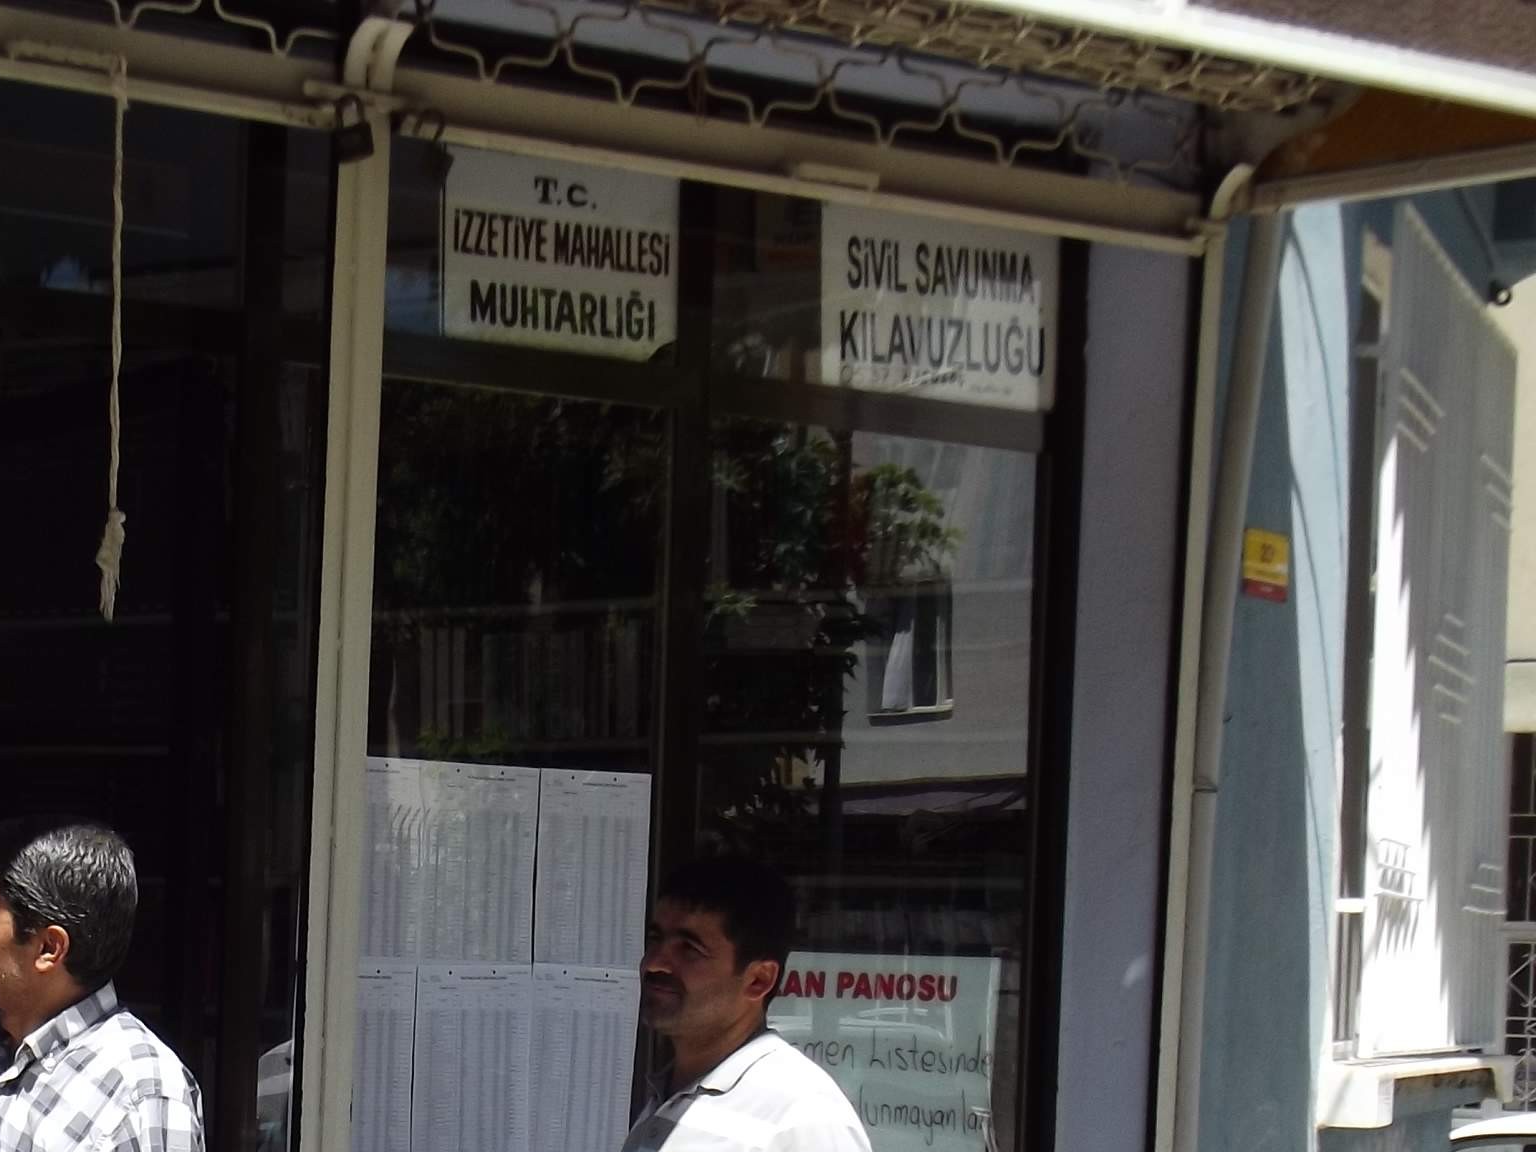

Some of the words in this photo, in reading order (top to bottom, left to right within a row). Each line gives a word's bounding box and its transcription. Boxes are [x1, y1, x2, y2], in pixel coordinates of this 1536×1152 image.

[533, 175, 597, 210] T.C.
[452, 207, 548, 264] İZZETİYE
[553, 219, 671, 278] MAHALLESİ
[846, 235, 908, 293] SİVİL
[914, 239, 1036, 304] SAVUNMA
[469, 278, 656, 342] MUHTARLIĞI
[839, 310, 1046, 377] KILAVUZLUĞU
[776, 970, 826, 998] AN
[835, 971, 958, 1002] PANOSU
